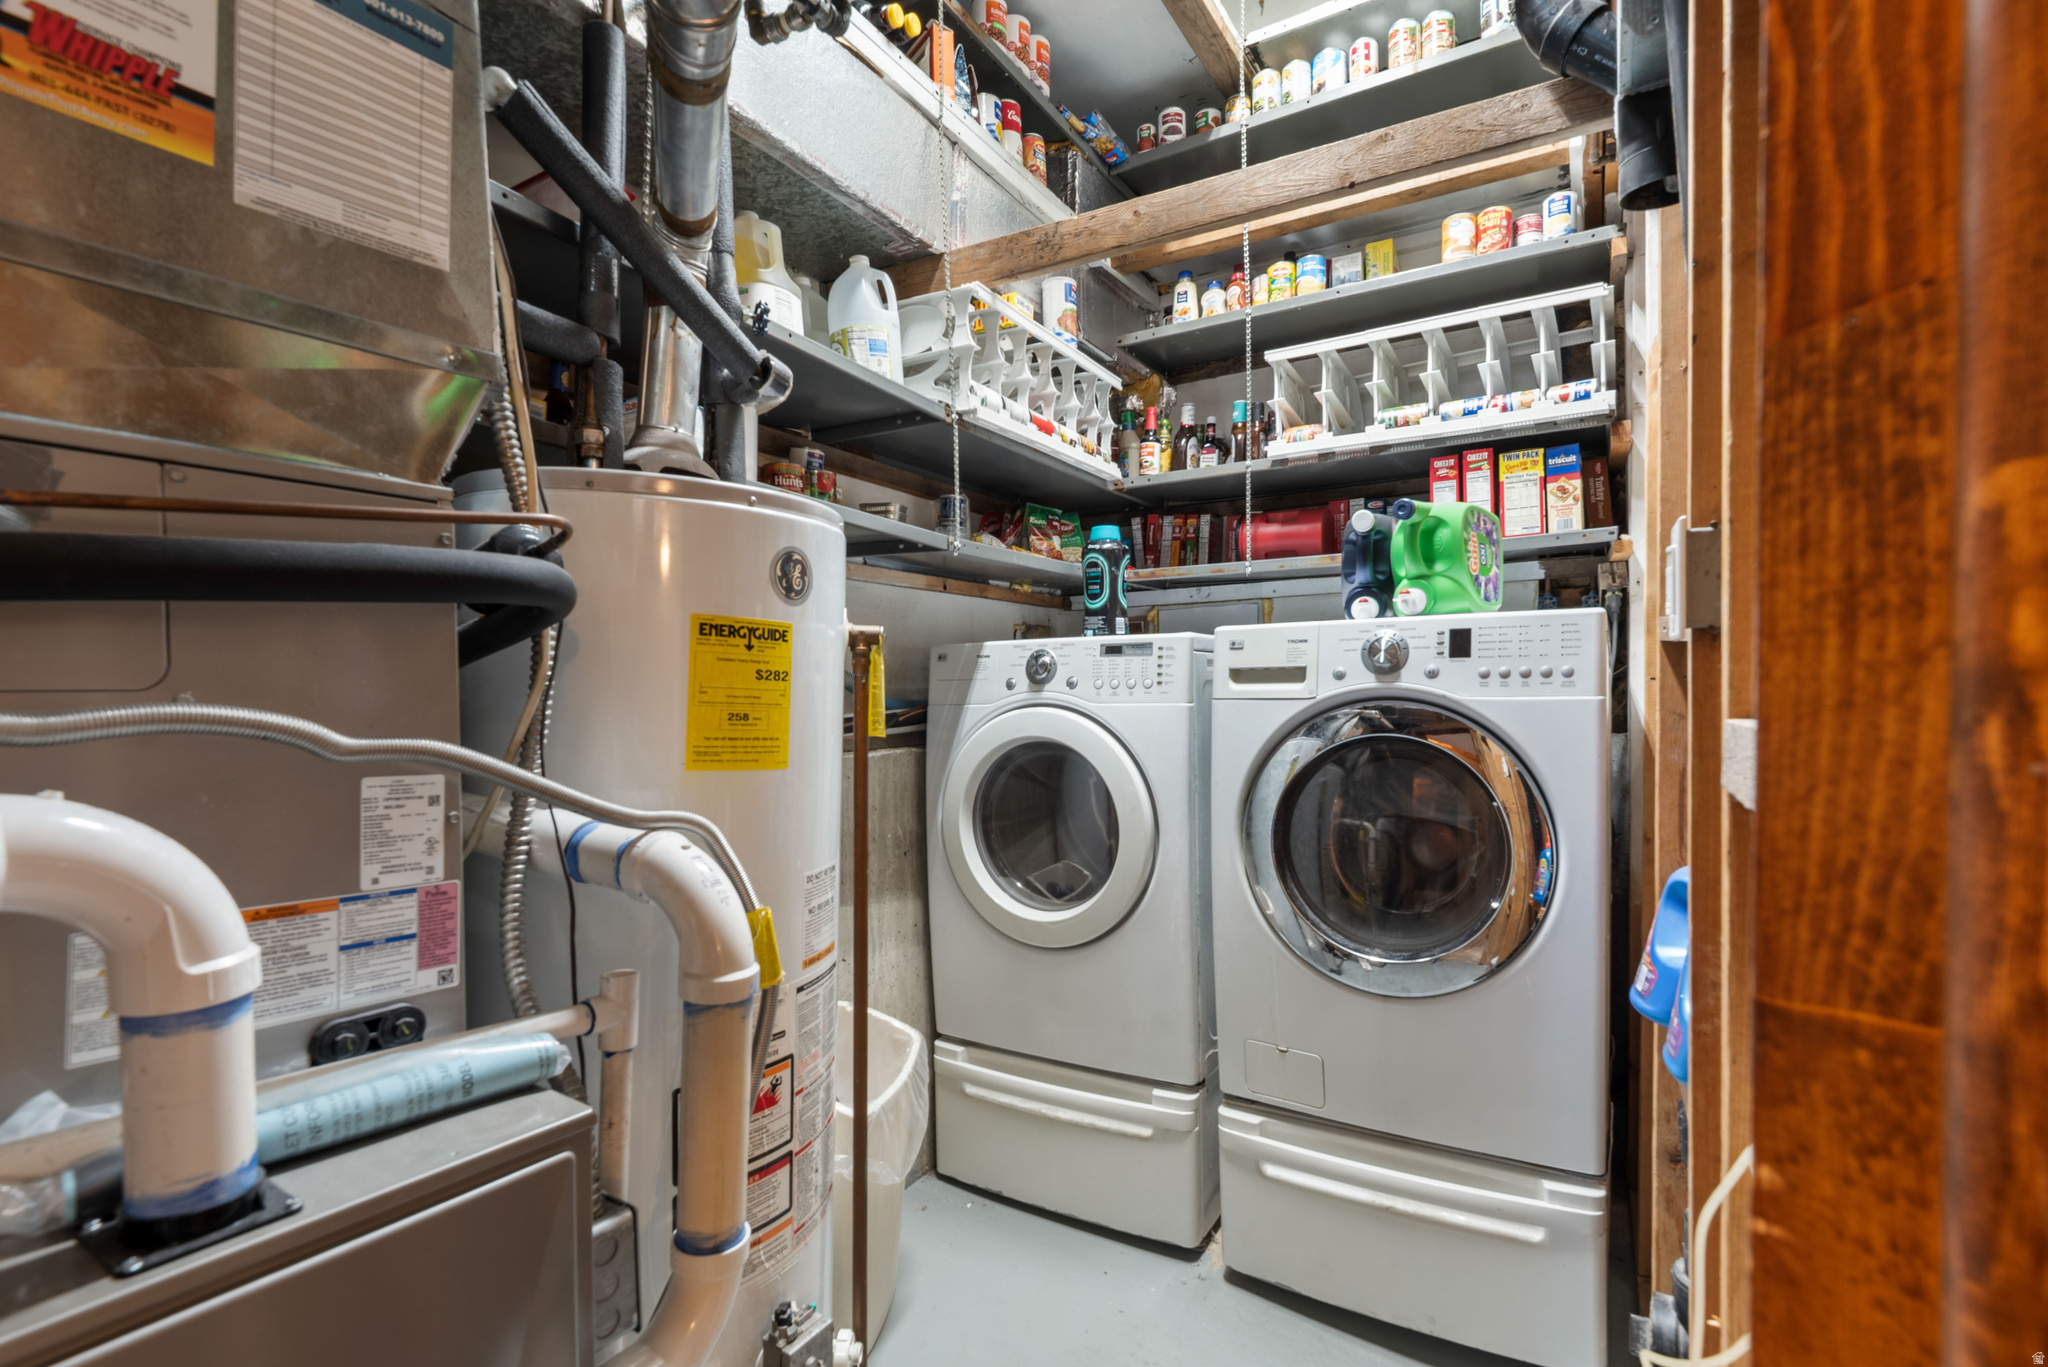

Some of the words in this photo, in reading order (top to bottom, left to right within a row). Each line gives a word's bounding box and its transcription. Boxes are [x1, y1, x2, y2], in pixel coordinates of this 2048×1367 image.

[24, 0, 180, 99] WHIPPLE
[1502, 453, 1521, 462] TWIN
[1522, 450, 1540, 460] PACK
[1548, 454, 1577, 465] triscuit
[1594, 476, 1605, 501] Turkey
[1029, 516, 1048, 526] Knorr
[1469, 532, 1479, 576] Gain
[699, 622, 789, 643] ENERGYGUIDE
[755, 669, 789, 682] $282
[727, 712, 750, 722] 258
